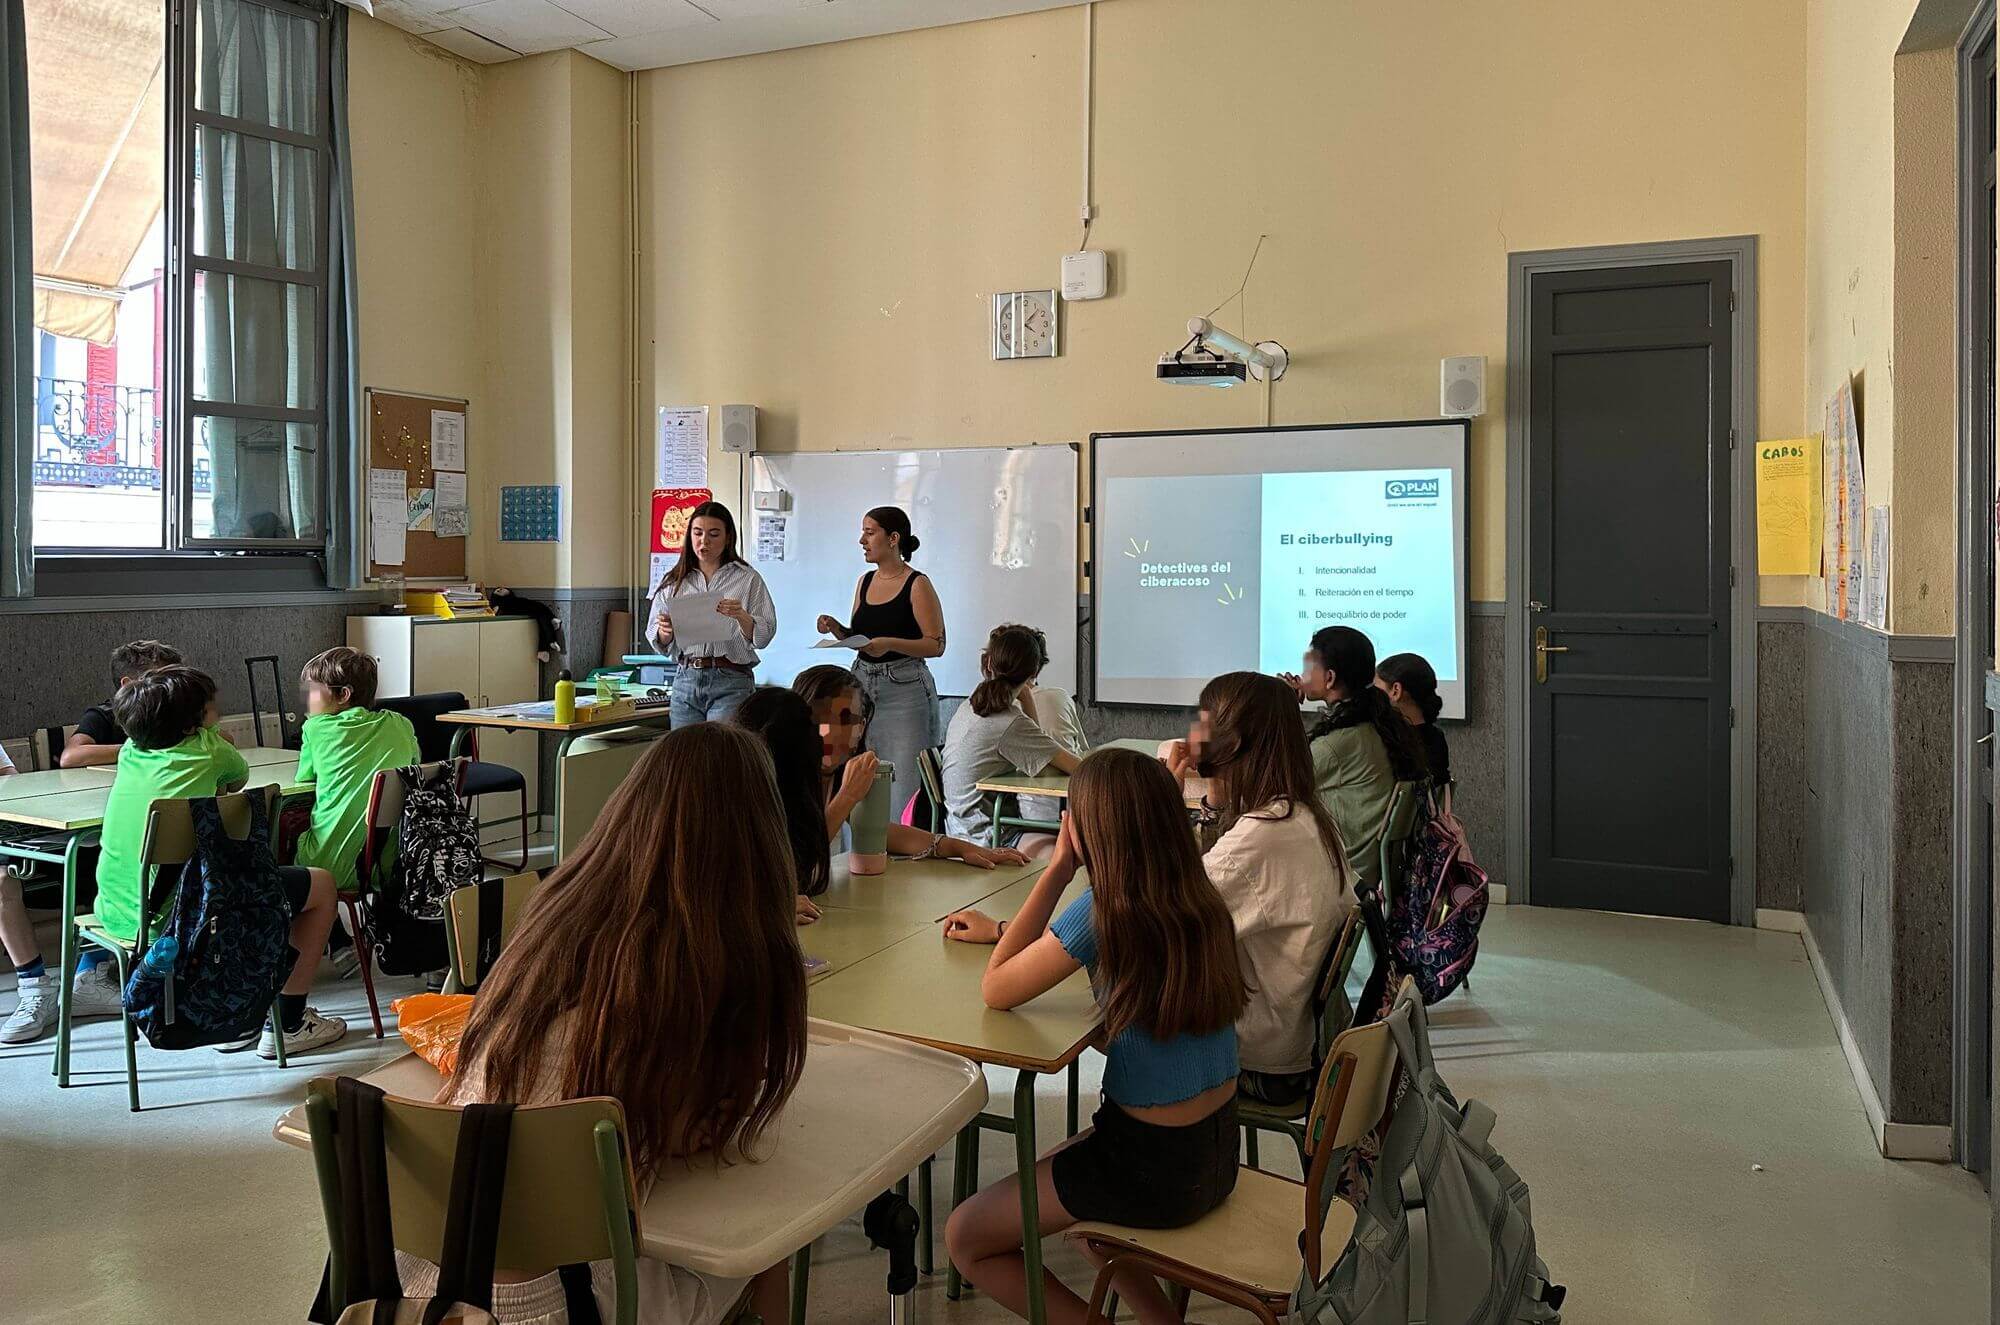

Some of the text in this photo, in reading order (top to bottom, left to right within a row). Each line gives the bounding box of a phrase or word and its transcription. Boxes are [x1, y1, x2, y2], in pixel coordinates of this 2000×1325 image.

[1043, 320, 1048, 328] 3
[1406, 482, 1437, 492] PLAN
[1280, 533, 1393, 547] El ciberbullying
[1140, 561, 1231, 574] Detectives del
[1315, 566, 1377, 575] Intencionalidad
[1140, 576, 1210, 587] ciberacoso
[1315, 588, 1362, 597] Reiteración
[1363, 589, 1374, 597] en
[1375, 588, 1384, 597] el
[1385, 588, 1414, 598] tiempo
[1315, 610, 1369, 620] Desequilibrio
[1370, 610, 1381, 619] de
[1382, 610, 1407, 620] poder
